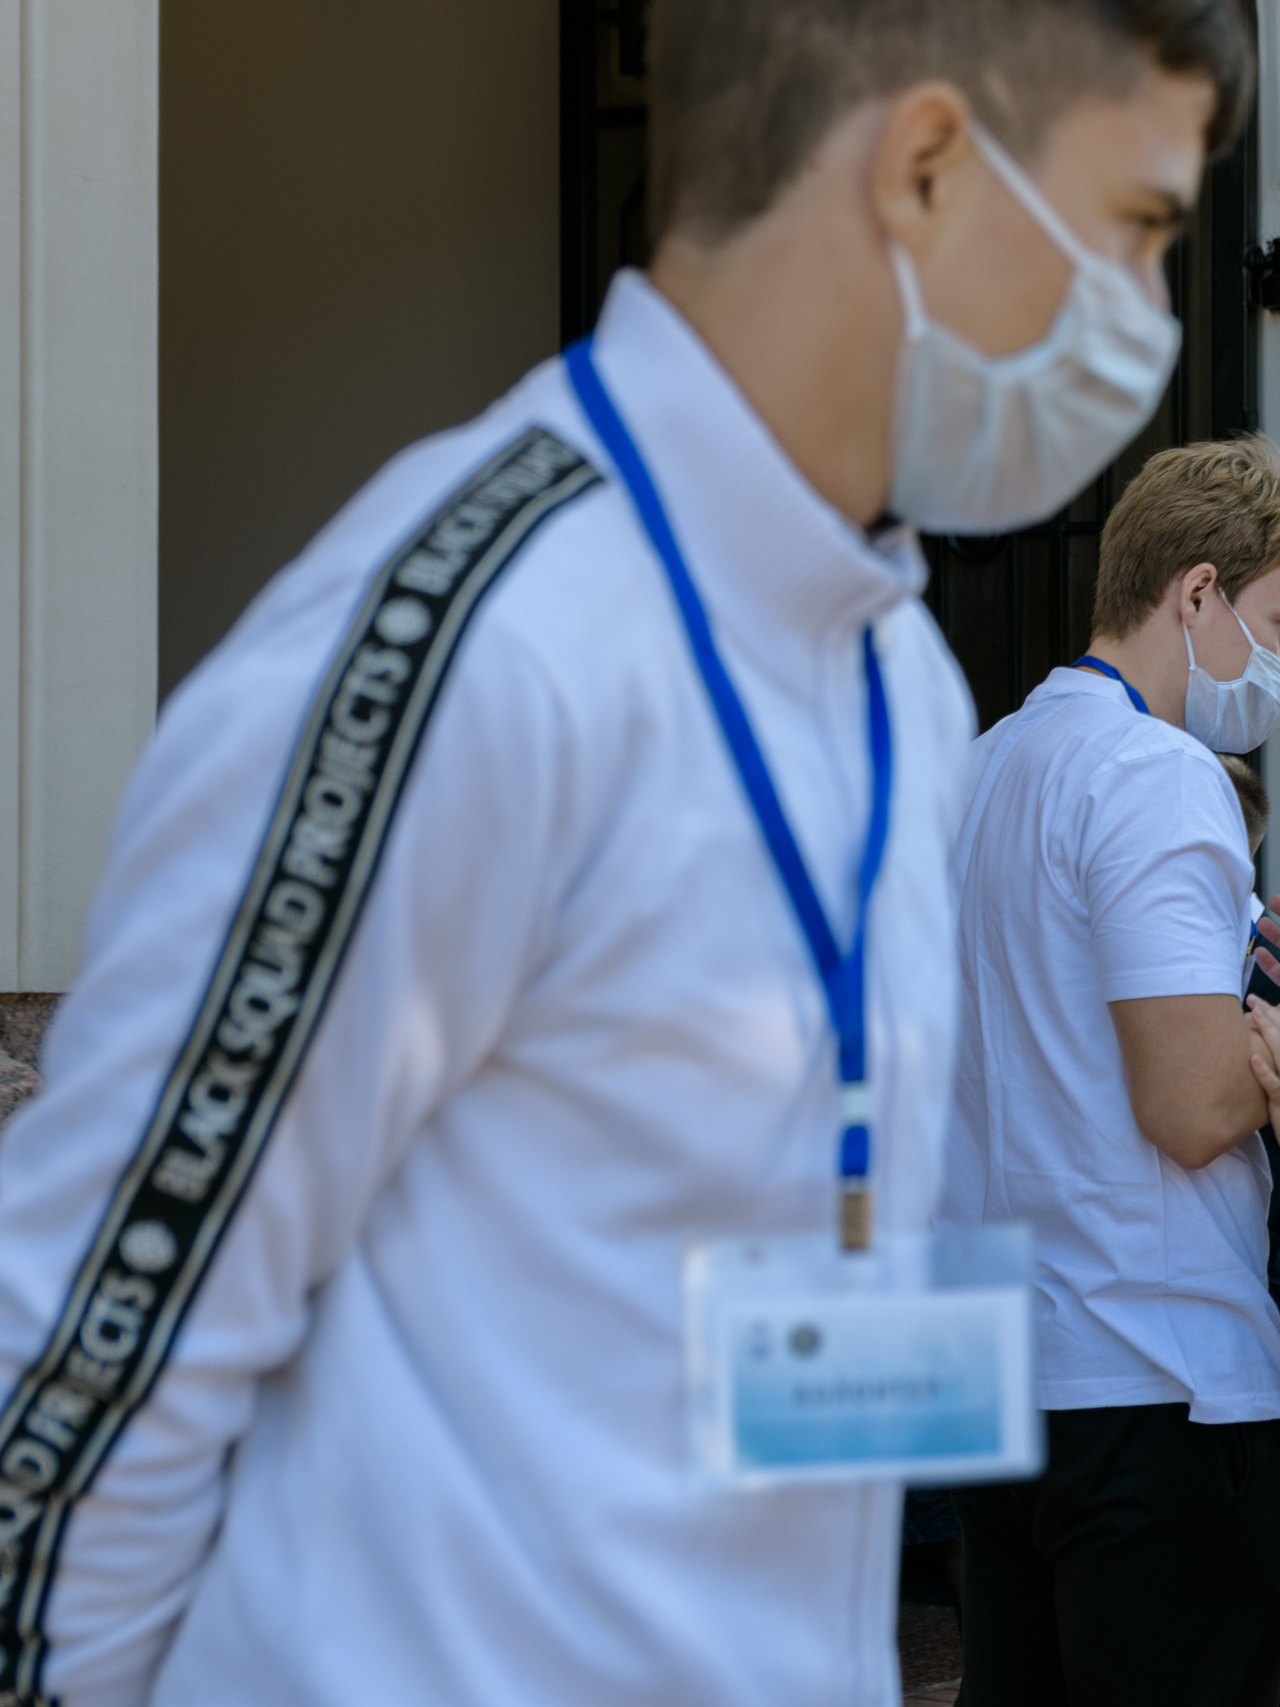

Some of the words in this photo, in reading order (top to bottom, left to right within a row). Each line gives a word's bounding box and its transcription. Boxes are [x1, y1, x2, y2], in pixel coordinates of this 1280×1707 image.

[152, 1050, 264, 1203] BLACK
[216, 879, 326, 1064] SQUAD
[282, 642, 413, 889] PROJECTS
[25, 1267, 156, 1451] PRECTS
